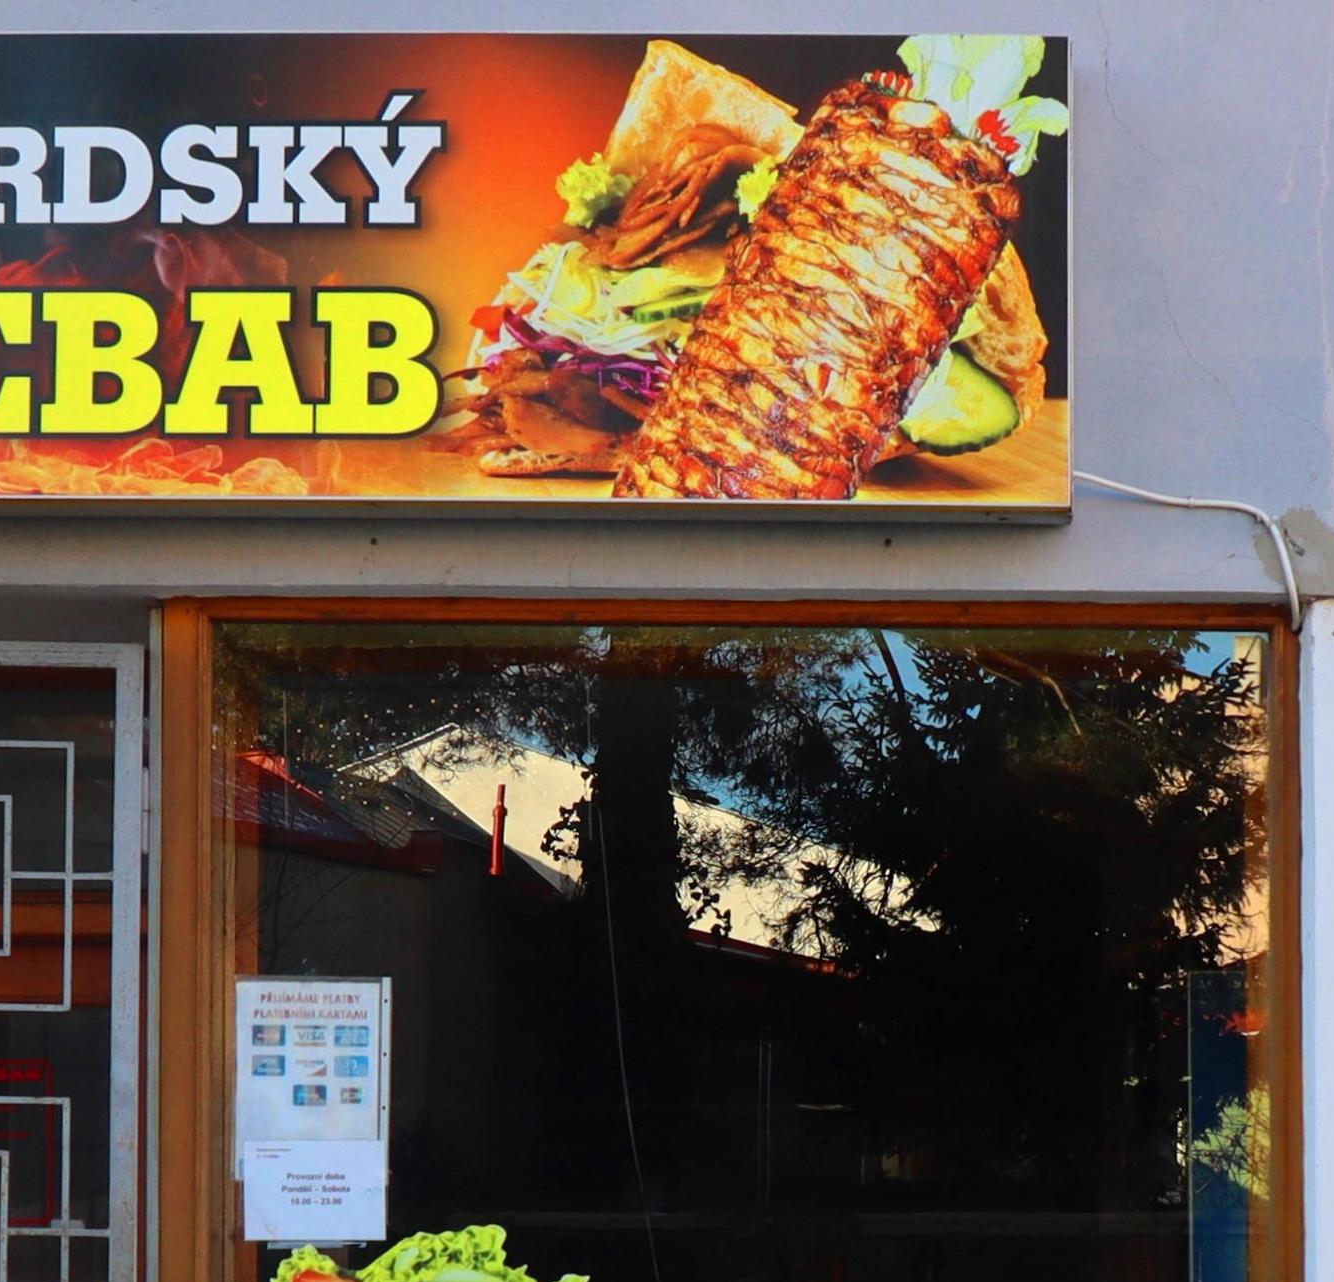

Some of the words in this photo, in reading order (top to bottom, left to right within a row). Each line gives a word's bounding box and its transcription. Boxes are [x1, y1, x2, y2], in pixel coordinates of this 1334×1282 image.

[323, 994, 361, 1004] PLATBY
[298, 1031, 325, 1041] VISA
[325, 1172, 346, 1181] doba
[322, 1184, 351, 1193] Sobota
